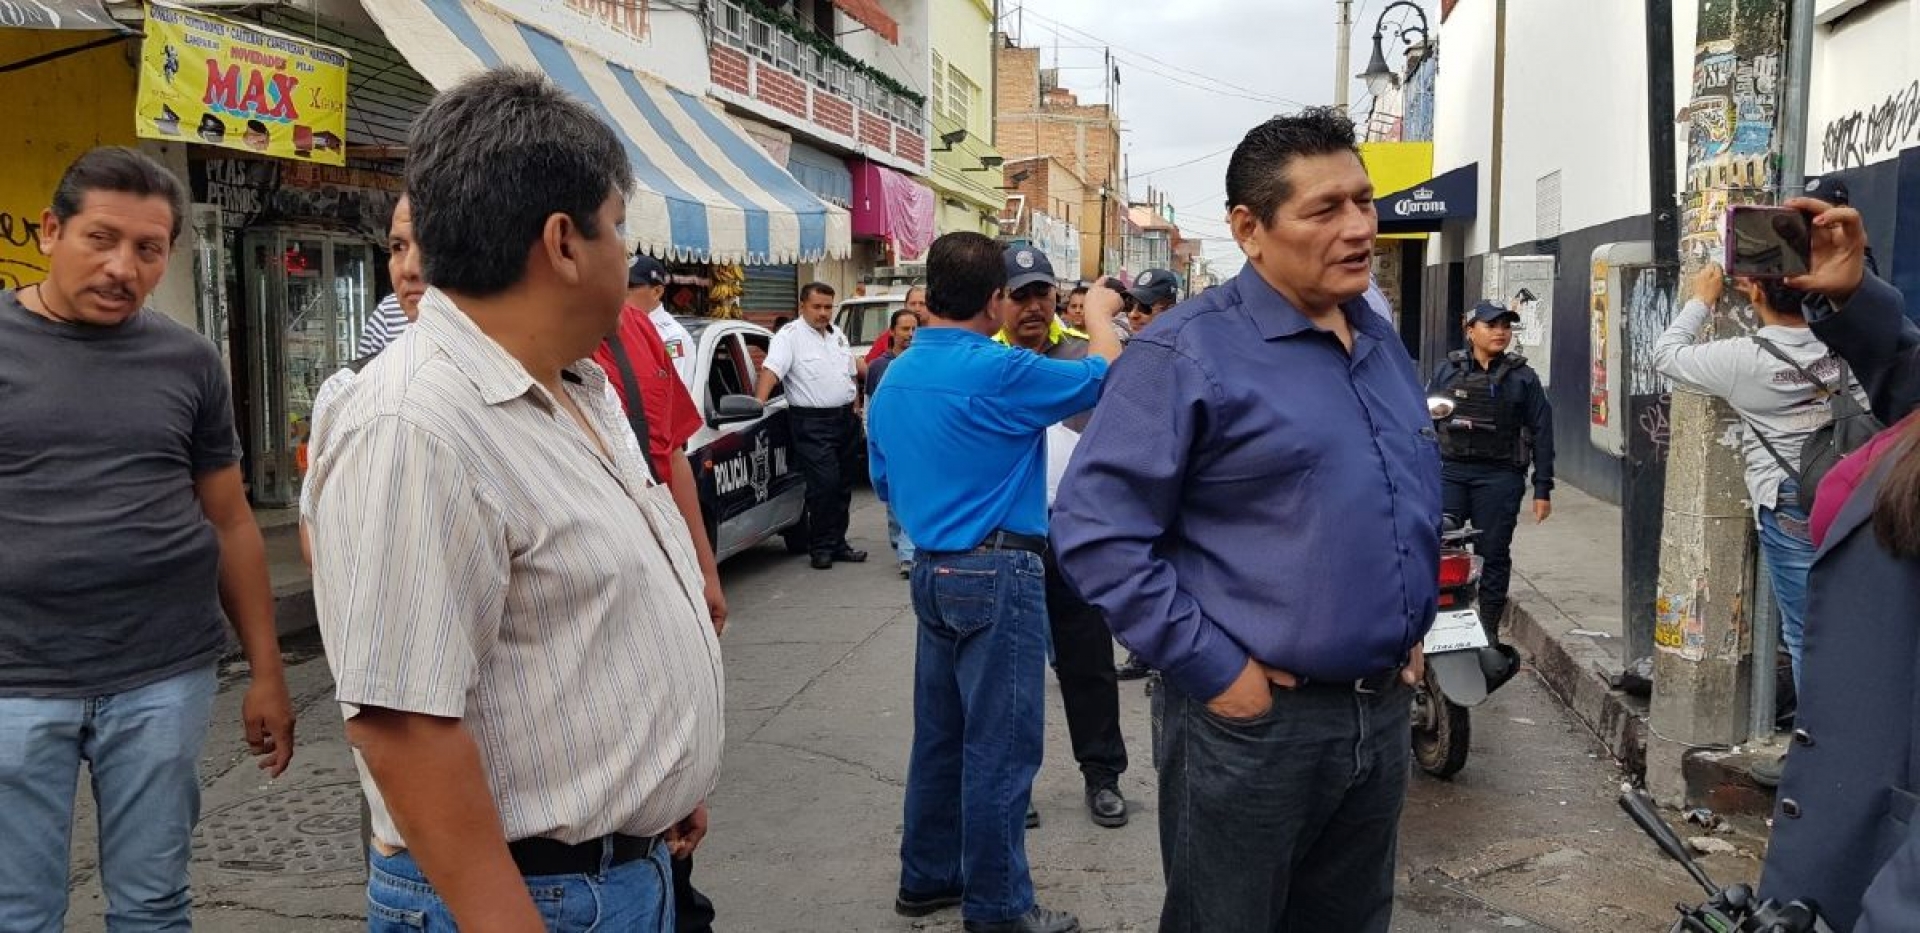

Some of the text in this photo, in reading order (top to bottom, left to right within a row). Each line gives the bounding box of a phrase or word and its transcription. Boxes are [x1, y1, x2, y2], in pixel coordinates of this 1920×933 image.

[230, 46, 287, 70] NOVEDADES
[202, 59, 300, 120] MAX
[1395, 199, 1448, 216] Corona
[713, 450, 747, 496] POLICÍA
